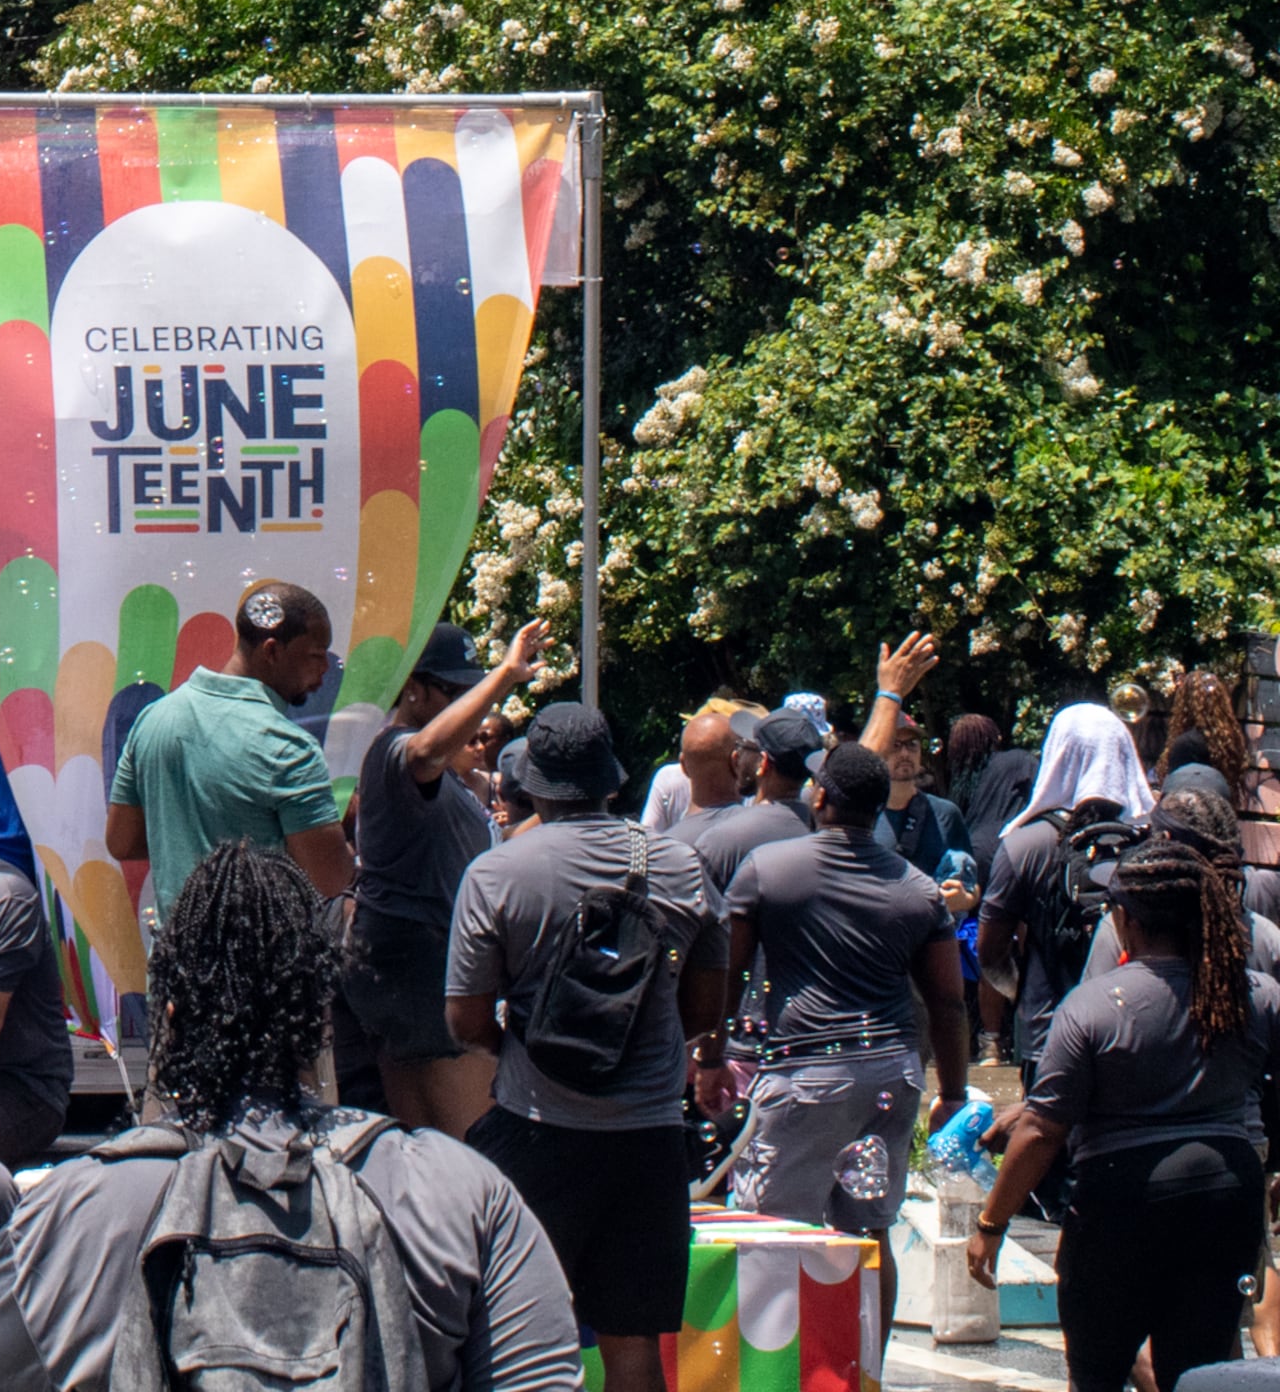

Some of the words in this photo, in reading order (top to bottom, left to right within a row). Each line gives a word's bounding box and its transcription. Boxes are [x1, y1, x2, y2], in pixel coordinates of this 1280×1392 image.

[85, 325, 324, 353] CELEBRATING
[90, 363, 327, 453] JUNE
[92, 447, 324, 533] TEENTH
